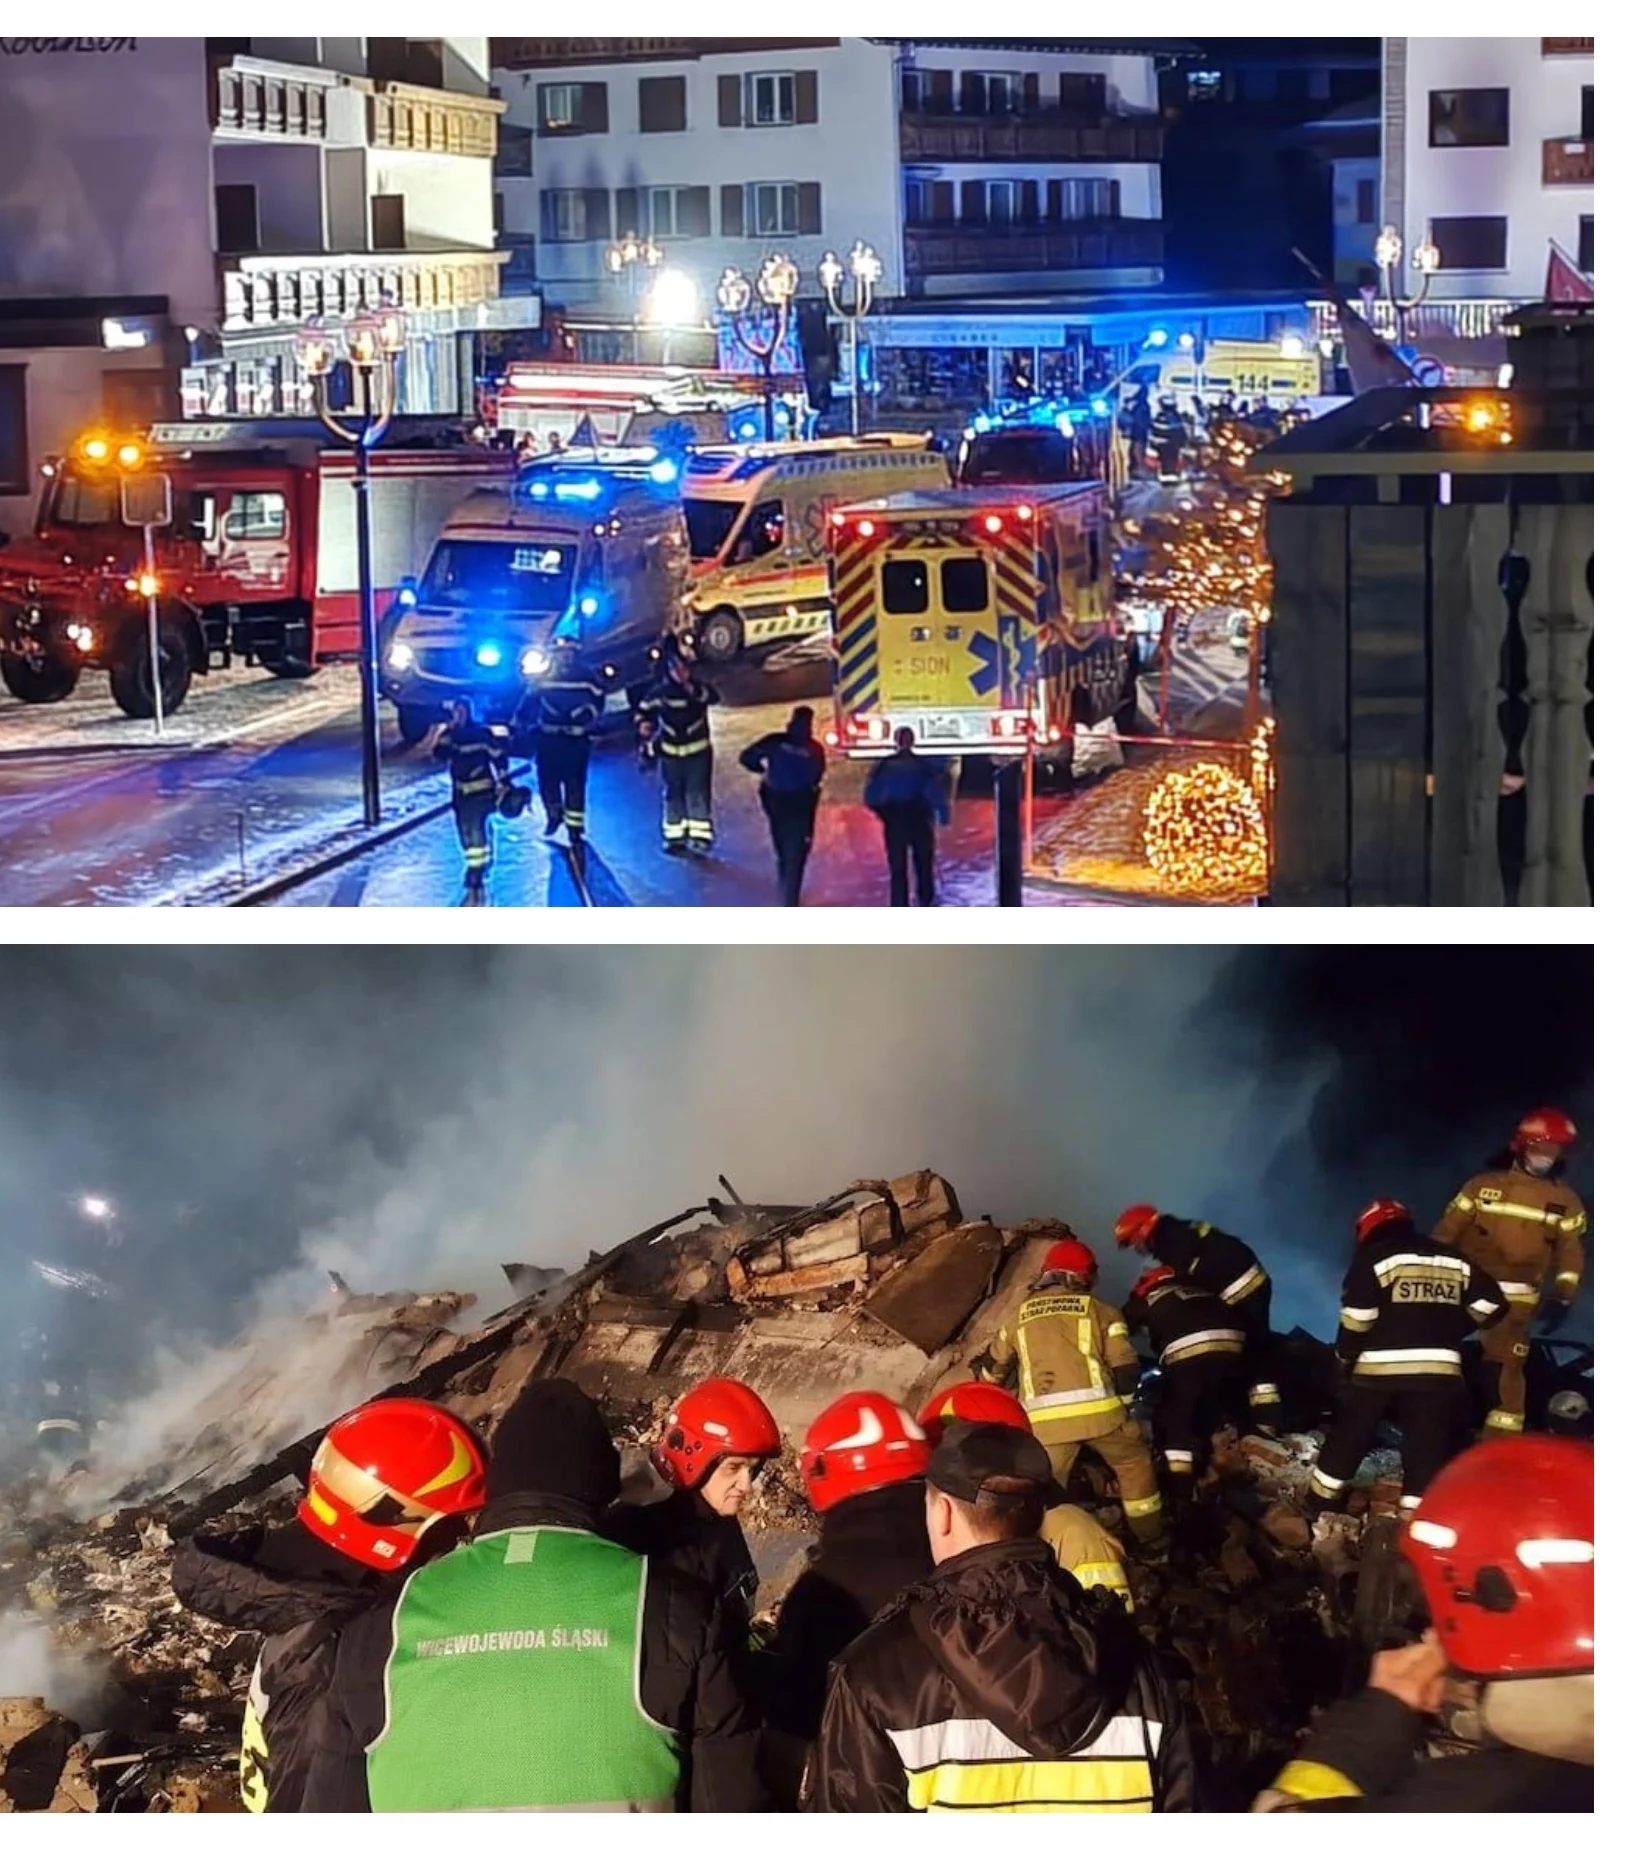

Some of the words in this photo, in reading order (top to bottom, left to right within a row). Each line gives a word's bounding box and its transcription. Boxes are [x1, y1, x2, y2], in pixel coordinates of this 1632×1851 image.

[1238, 374, 1269, 391] 144
[910, 656, 951, 675] SION
[552, 1624, 609, 1651] ŚLĄSKI
